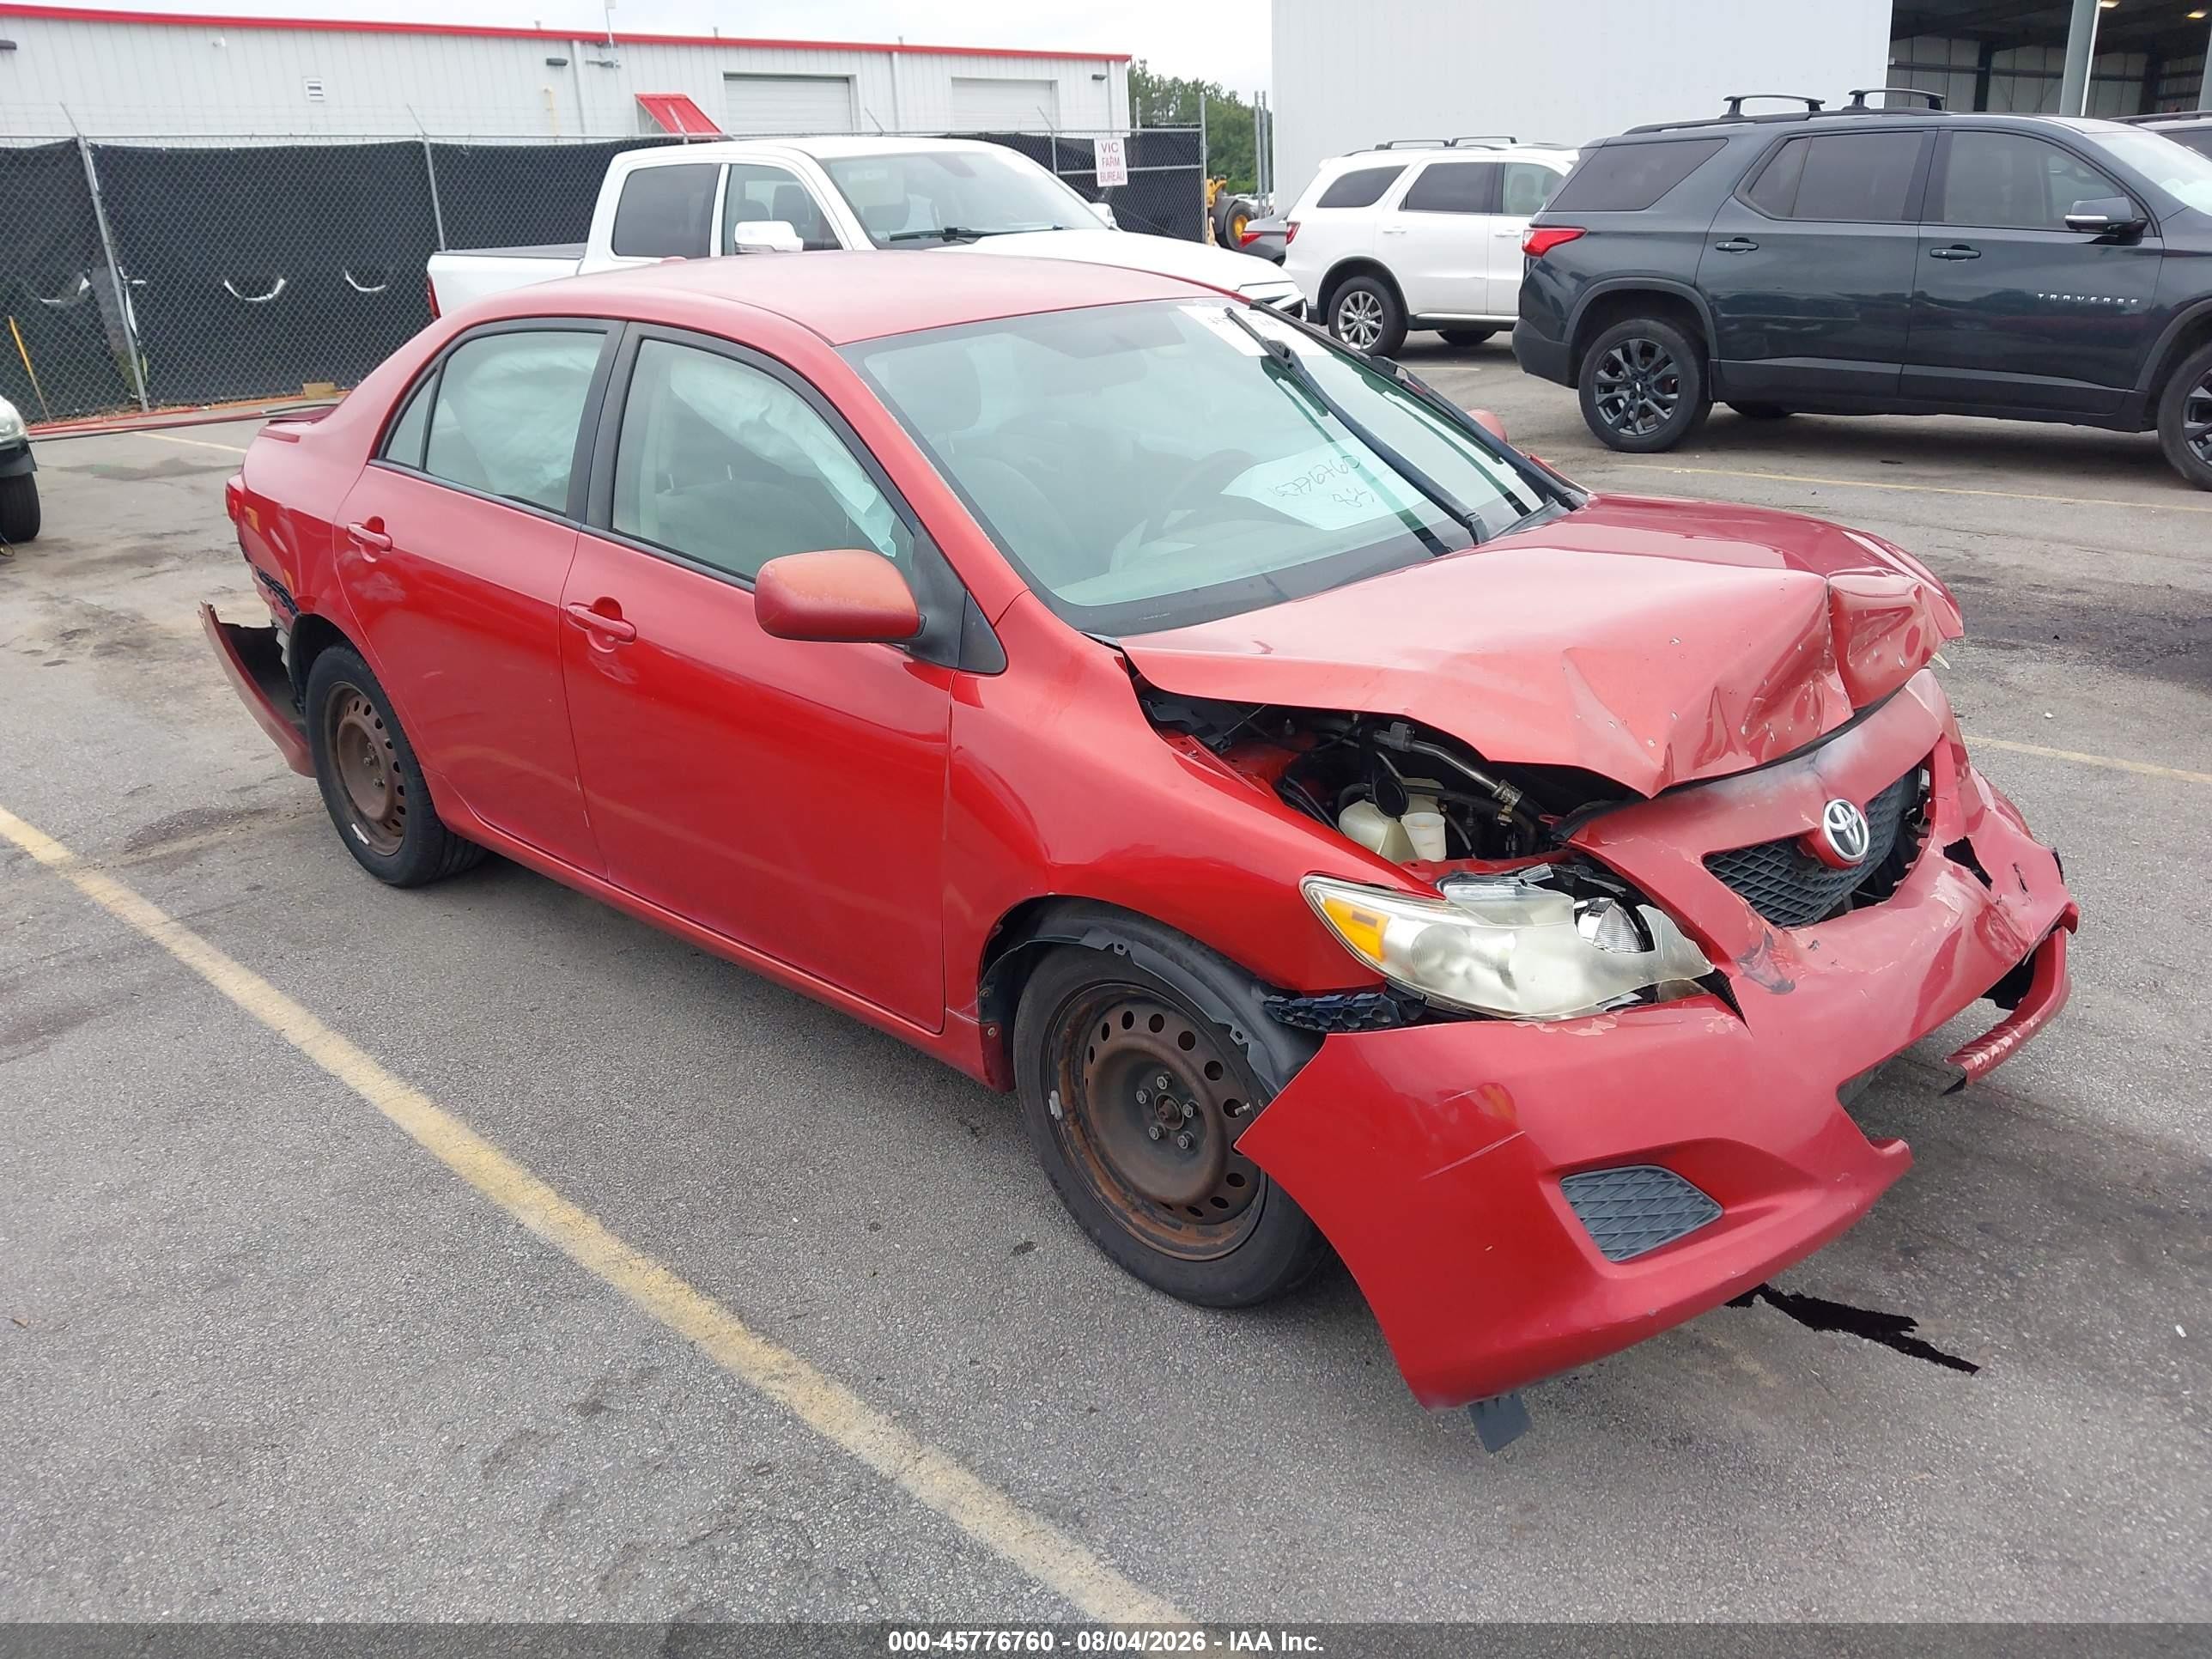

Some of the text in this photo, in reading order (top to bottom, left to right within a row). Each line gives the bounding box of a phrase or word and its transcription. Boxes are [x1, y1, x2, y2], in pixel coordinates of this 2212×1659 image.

[1101, 143, 1119, 153] VIC
[1102, 157, 1121, 167] FARM
[1100, 172, 1126, 182] BUREAU
[2037, 293, 2139, 305] TRAVERSE
